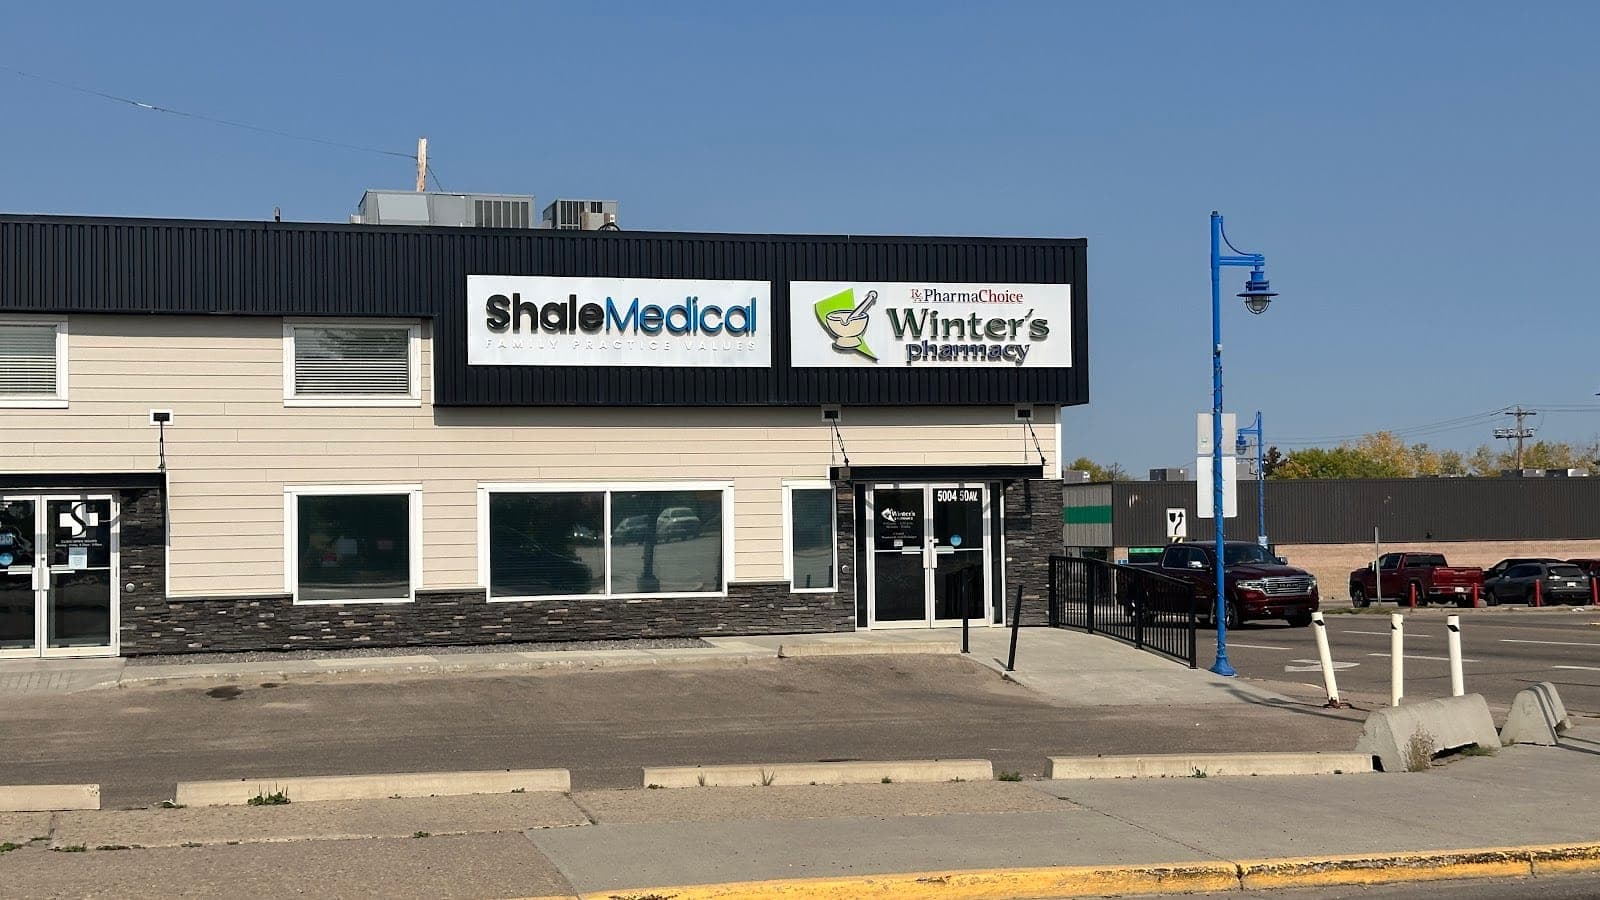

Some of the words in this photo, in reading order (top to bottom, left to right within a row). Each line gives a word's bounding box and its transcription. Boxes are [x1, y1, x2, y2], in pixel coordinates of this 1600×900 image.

[924, 288, 1023, 303] PharmaChoice
[887, 308, 1050, 340] Winter's
[486, 339, 558, 350] FAMILY
[573, 340, 672, 351] PRACTICE
[683, 341, 757, 351] VALUES
[906, 340, 1031, 366] pharmacy
[937, 490, 958, 502] 5004
